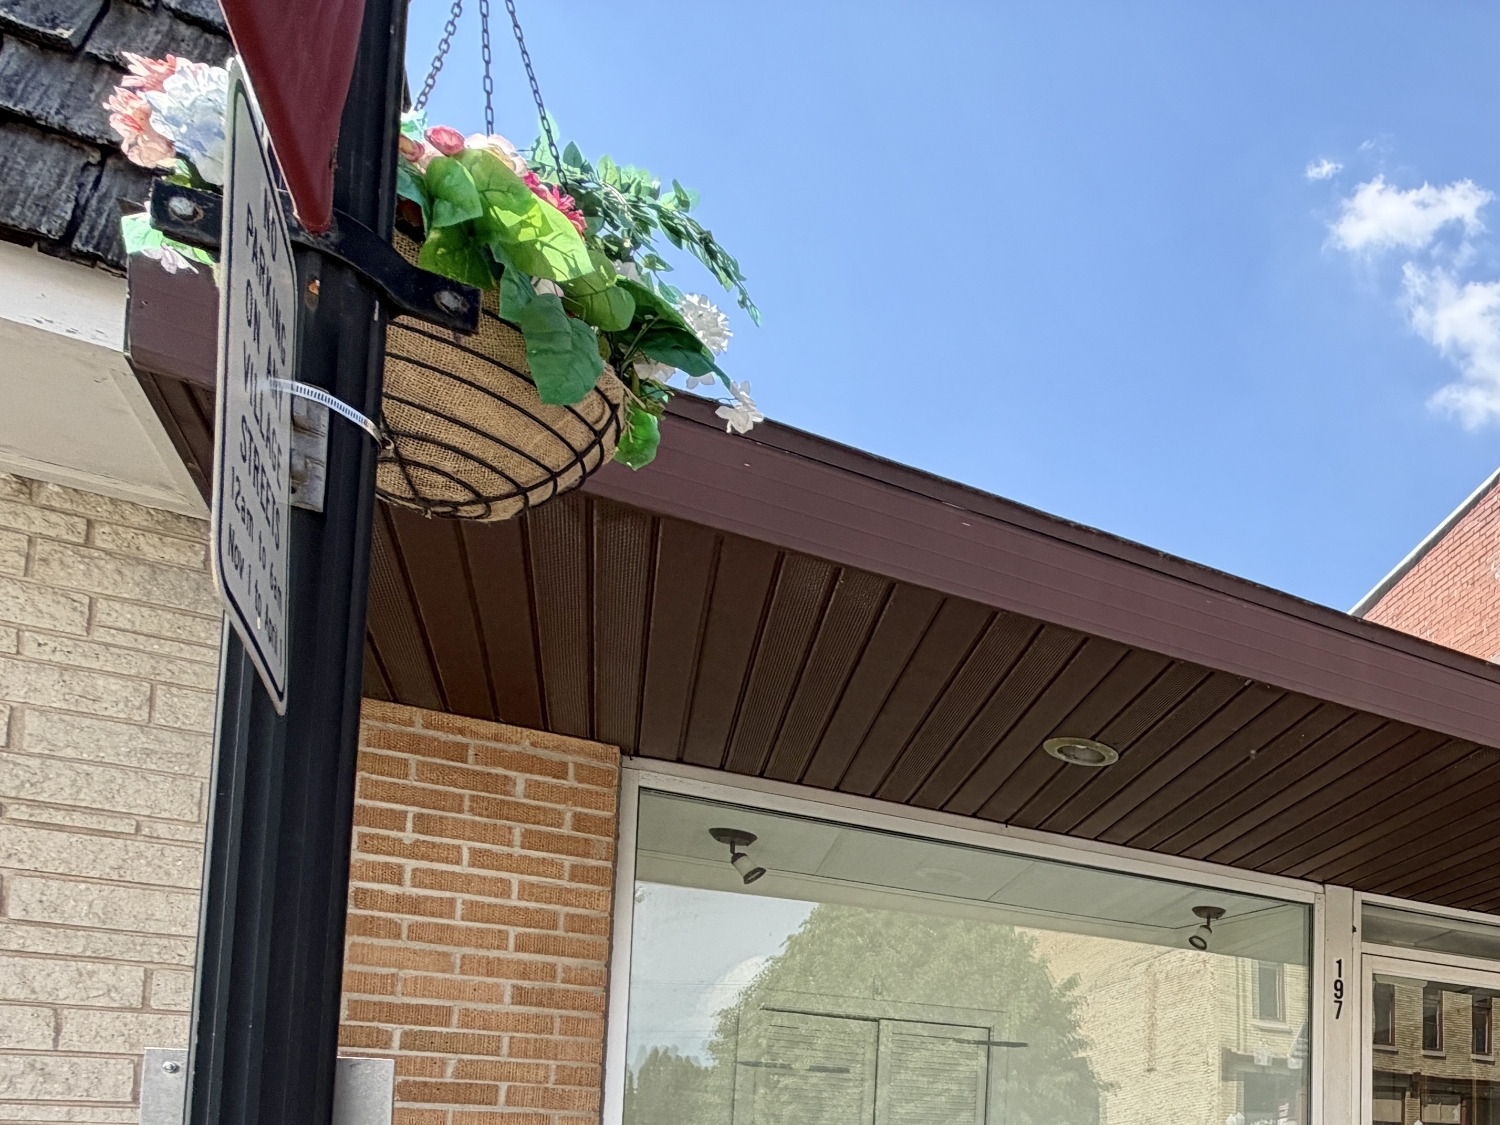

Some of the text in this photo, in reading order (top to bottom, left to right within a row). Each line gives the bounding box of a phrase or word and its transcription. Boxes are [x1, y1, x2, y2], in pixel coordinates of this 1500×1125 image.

[246, 202, 287, 367] PARKING
[263, 187, 277, 262] NO
[245, 278, 283, 423] ON ANY
[243, 340, 283, 491] VILLAGE
[231, 465, 254, 544] 12am
[258, 529, 267, 571] to
[240, 414, 280, 552] STREETS
[227, 522, 245, 580] Nov
[254, 578, 263, 618] to
[1333, 958, 1344, 1020] 197
